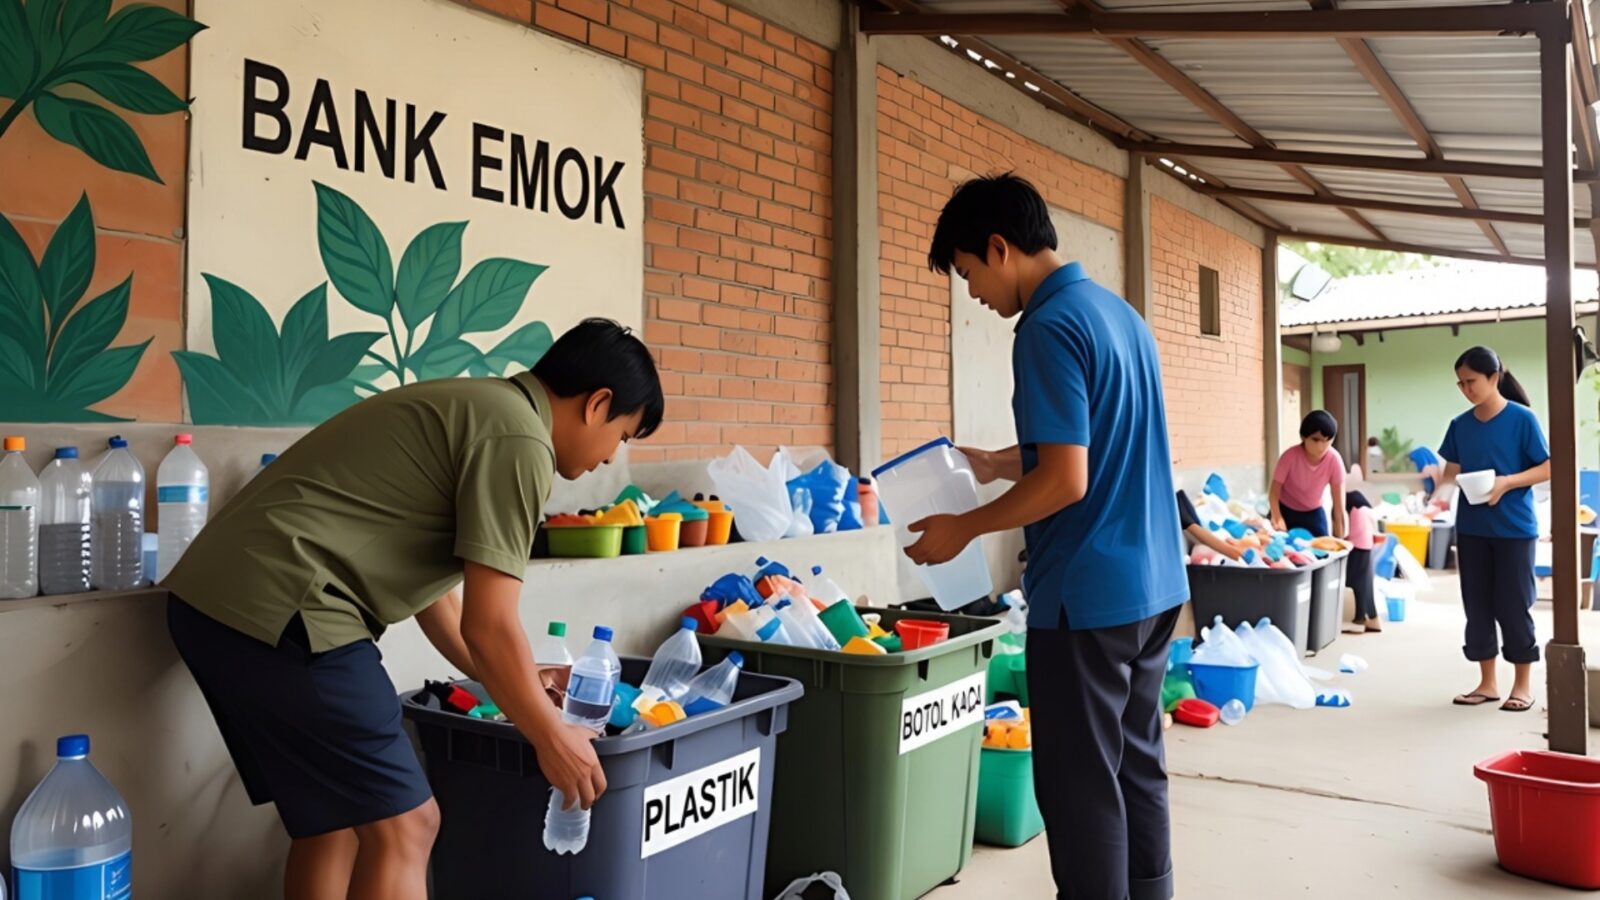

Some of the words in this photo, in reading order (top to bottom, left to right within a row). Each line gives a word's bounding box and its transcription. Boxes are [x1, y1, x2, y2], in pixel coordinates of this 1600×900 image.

[242, 58, 448, 191] BANK
[472, 122, 626, 230] EMOK
[903, 698, 948, 741] BOTOL
[644, 762, 757, 842] PLASTIK
